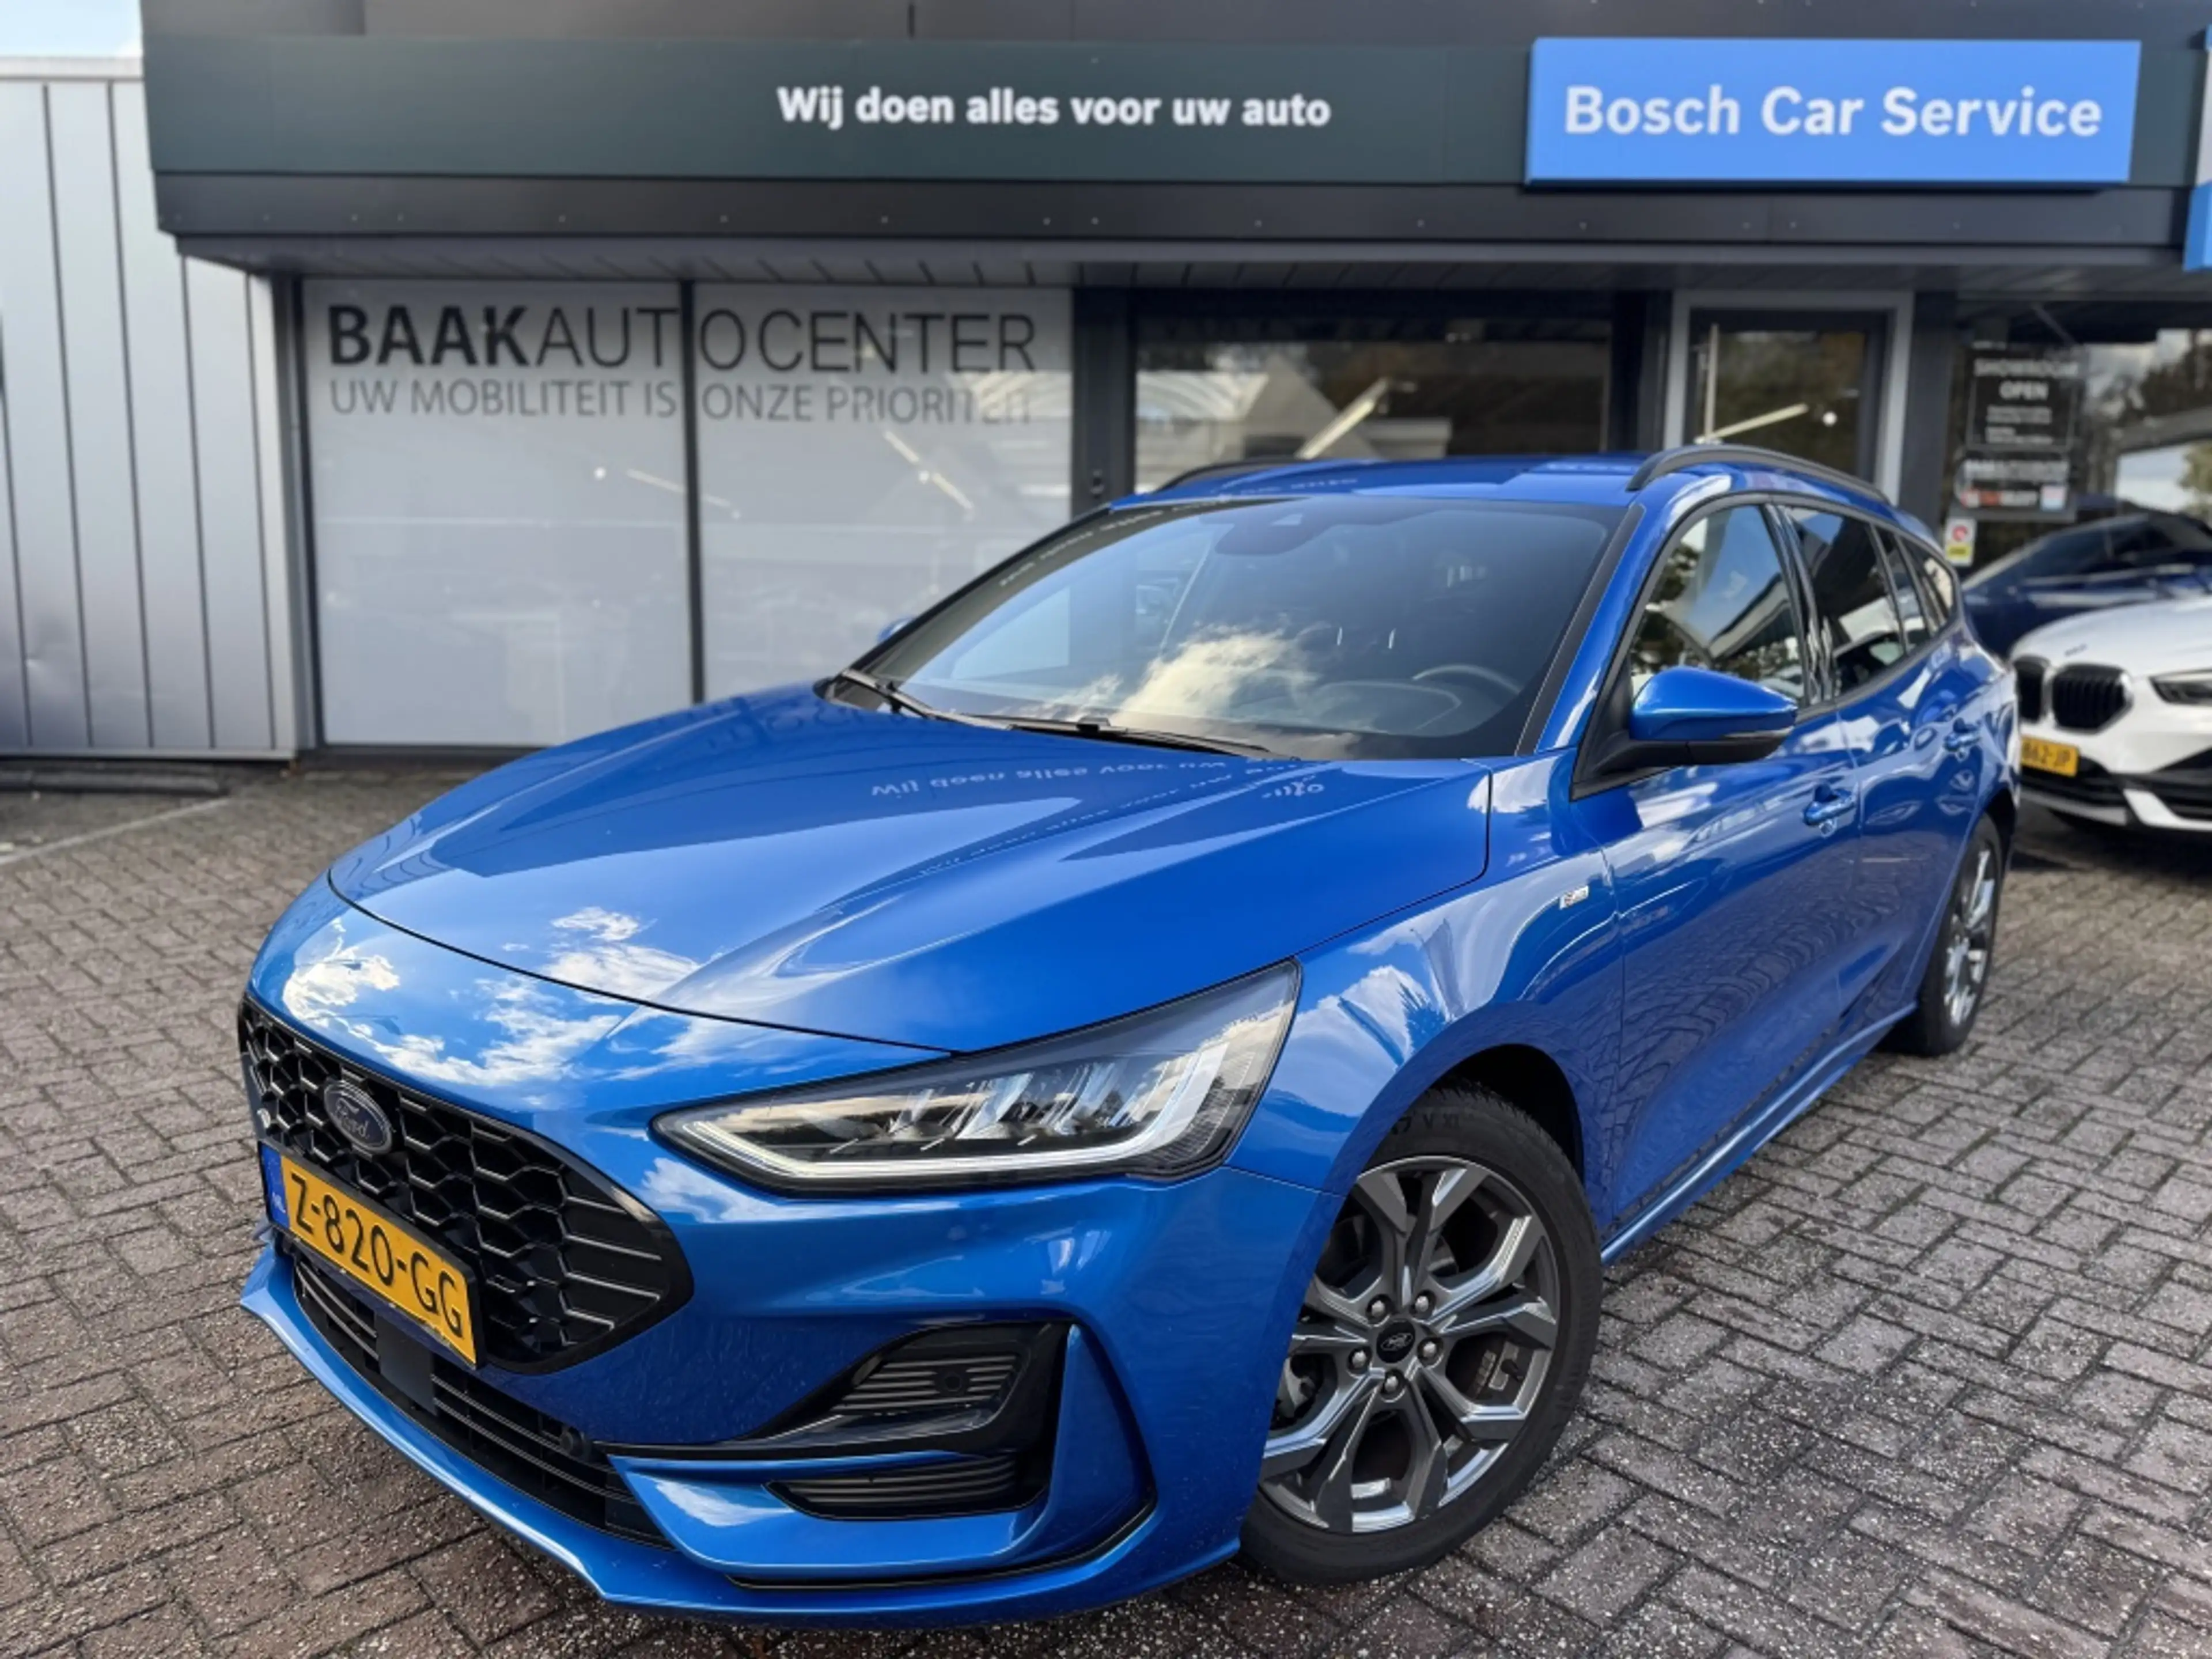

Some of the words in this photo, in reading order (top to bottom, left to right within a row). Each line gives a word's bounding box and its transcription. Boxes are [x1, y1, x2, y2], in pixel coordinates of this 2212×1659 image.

[777, 86, 843, 130] Wij
[855, 86, 954, 123] doen
[967, 88, 1059, 124] alles
[1071, 97, 1161, 125] voor
[1173, 99, 1231, 126] uw
[1243, 94, 1331, 126] auto
[1565, 85, 1740, 135] Bosch
[1762, 86, 1864, 135] Car
[1881, 86, 2103, 136] Service
[330, 380, 397, 414] UW
[410, 380, 631, 416] MOBILITEIT
[644, 382, 677, 417] IS
[702, 384, 813, 422] ONZE
[1999, 381, 2048, 400] OPEN
[291, 1173, 464, 1339] Z-820-GG
